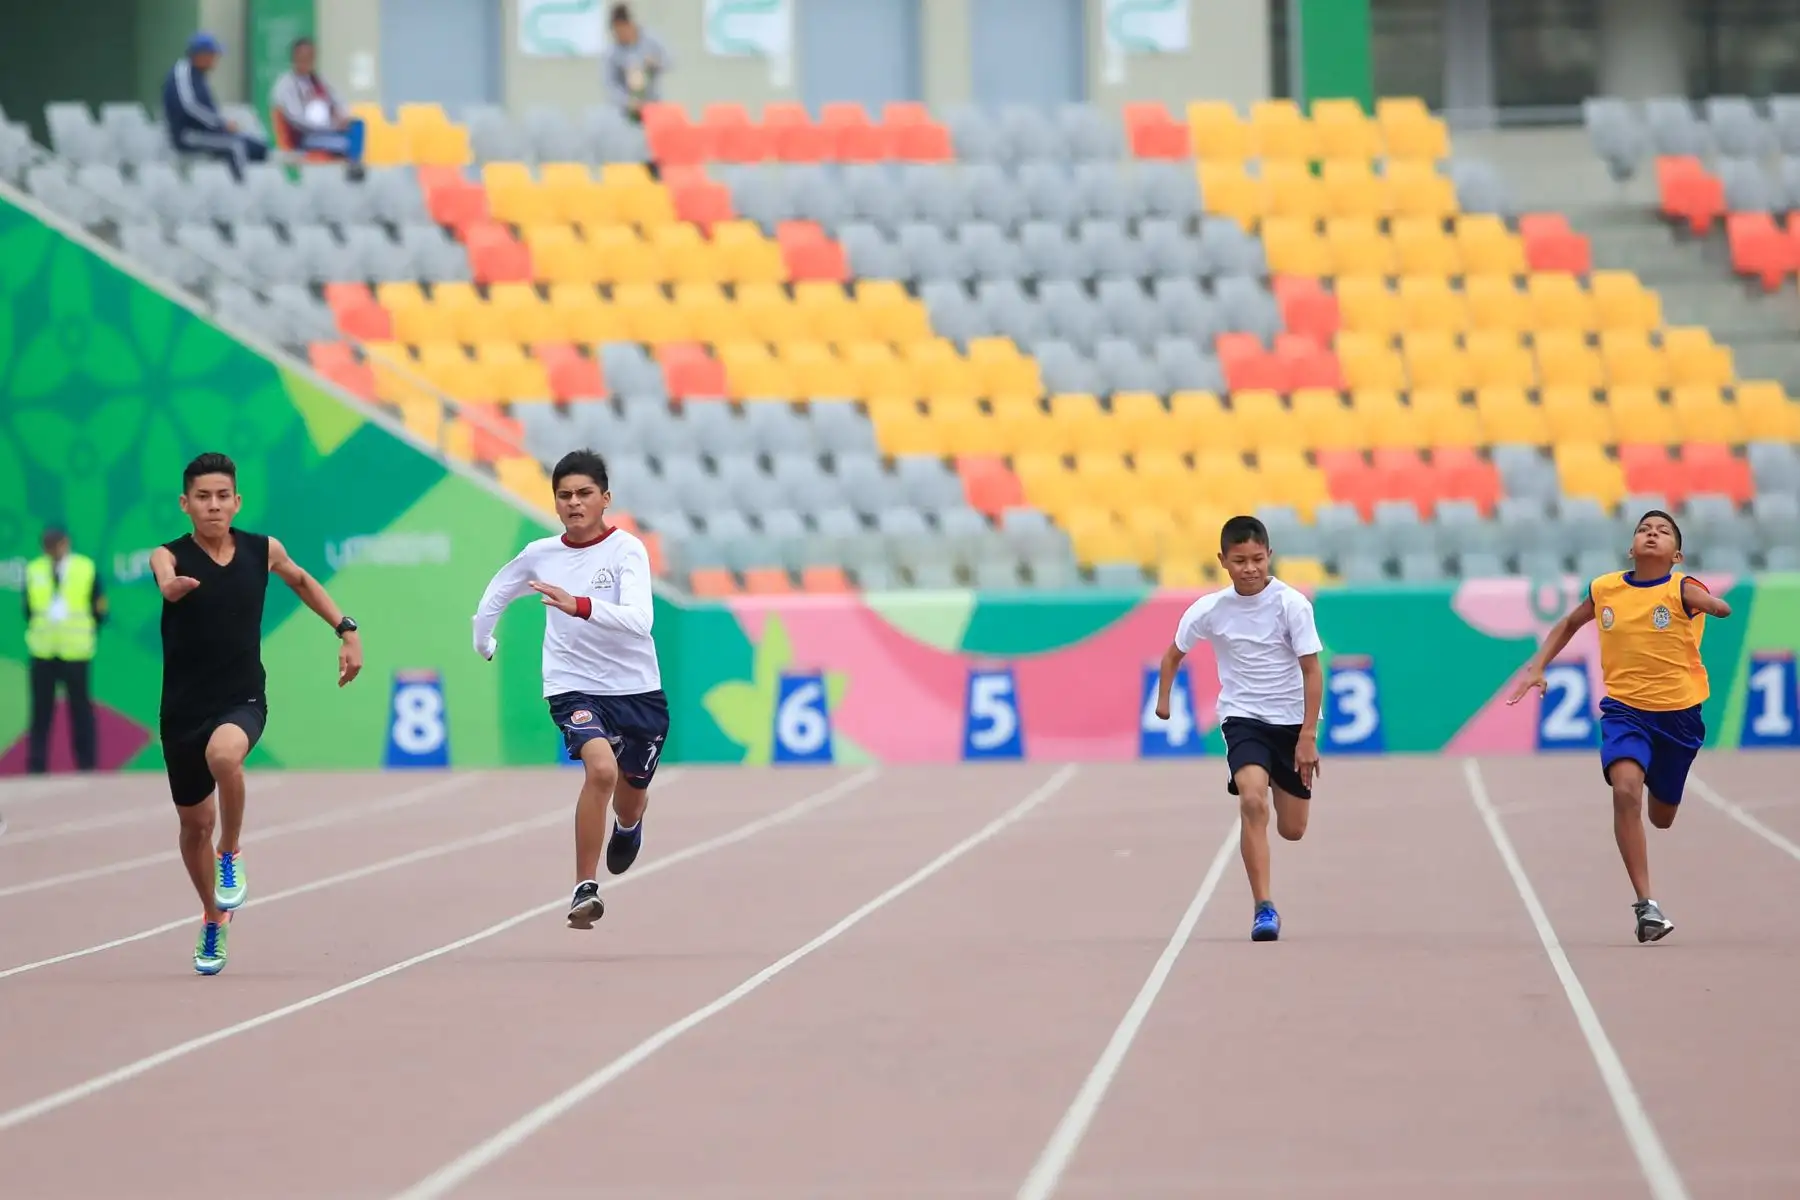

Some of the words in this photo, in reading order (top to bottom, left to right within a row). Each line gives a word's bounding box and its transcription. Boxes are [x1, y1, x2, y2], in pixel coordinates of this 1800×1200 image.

[393, 684, 446, 754] 8
[777, 682, 828, 754] 6
[970, 675, 1017, 749] 5
[1141, 676, 1193, 746] 4
[1329, 670, 1378, 744] 3
[1541, 667, 1592, 739] 2
[1750, 665, 1792, 736] 1
